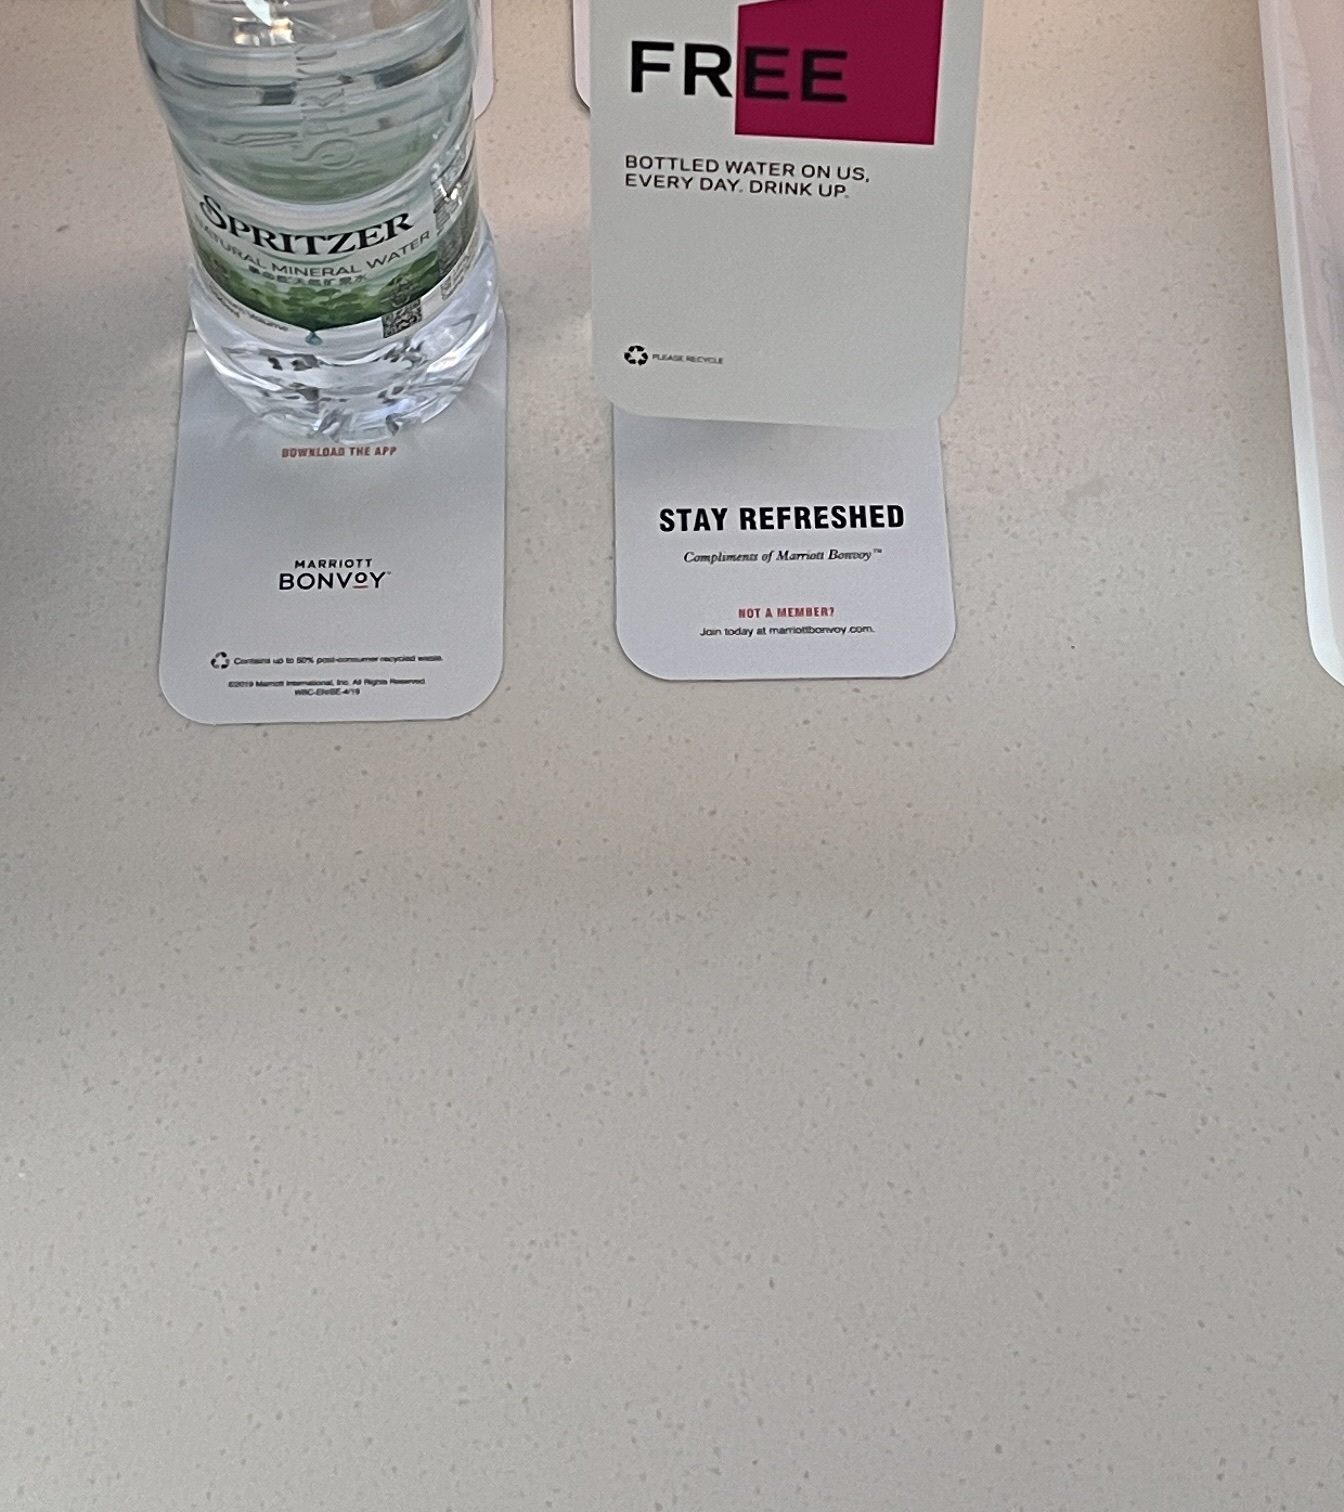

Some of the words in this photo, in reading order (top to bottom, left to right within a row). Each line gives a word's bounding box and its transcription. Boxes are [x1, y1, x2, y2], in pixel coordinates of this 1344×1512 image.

[630, 40, 848, 103] FREE
[625, 155, 719, 173] BOTTLED
[725, 159, 795, 177] WATER
[801, 164, 831, 179] ON
[837, 166, 870, 183] US,
[625, 173, 693, 190] EVERY
[699, 177, 744, 193] DAY.
[749, 180, 812, 196] DRINK
[818, 184, 850, 199] UP.
[199, 194, 415, 256] SPRITZER
[272, 261, 362, 277] MINERAL
[366, 231, 431, 270] WATER
[281, 447, 346, 458] DOWNLOAD
[350, 447, 371, 456] THE
[374, 446, 397, 456] APP
[659, 507, 728, 532] STAY
[739, 504, 905, 530] REFRESHED
[295, 558, 372, 569] MARRIOTT
[683, 551, 758, 565] Compliments
[761, 550, 775, 563] of
[775, 549, 825, 562] Marriott
[279, 571, 387, 590] BONVOY
[738, 607, 760, 619] NOT
[765, 607, 774, 618] A
[777, 606, 835, 618] MEMBER?
[699, 627, 722, 637] Join
[725, 626, 754, 638] today
[756, 626, 767, 635] at
